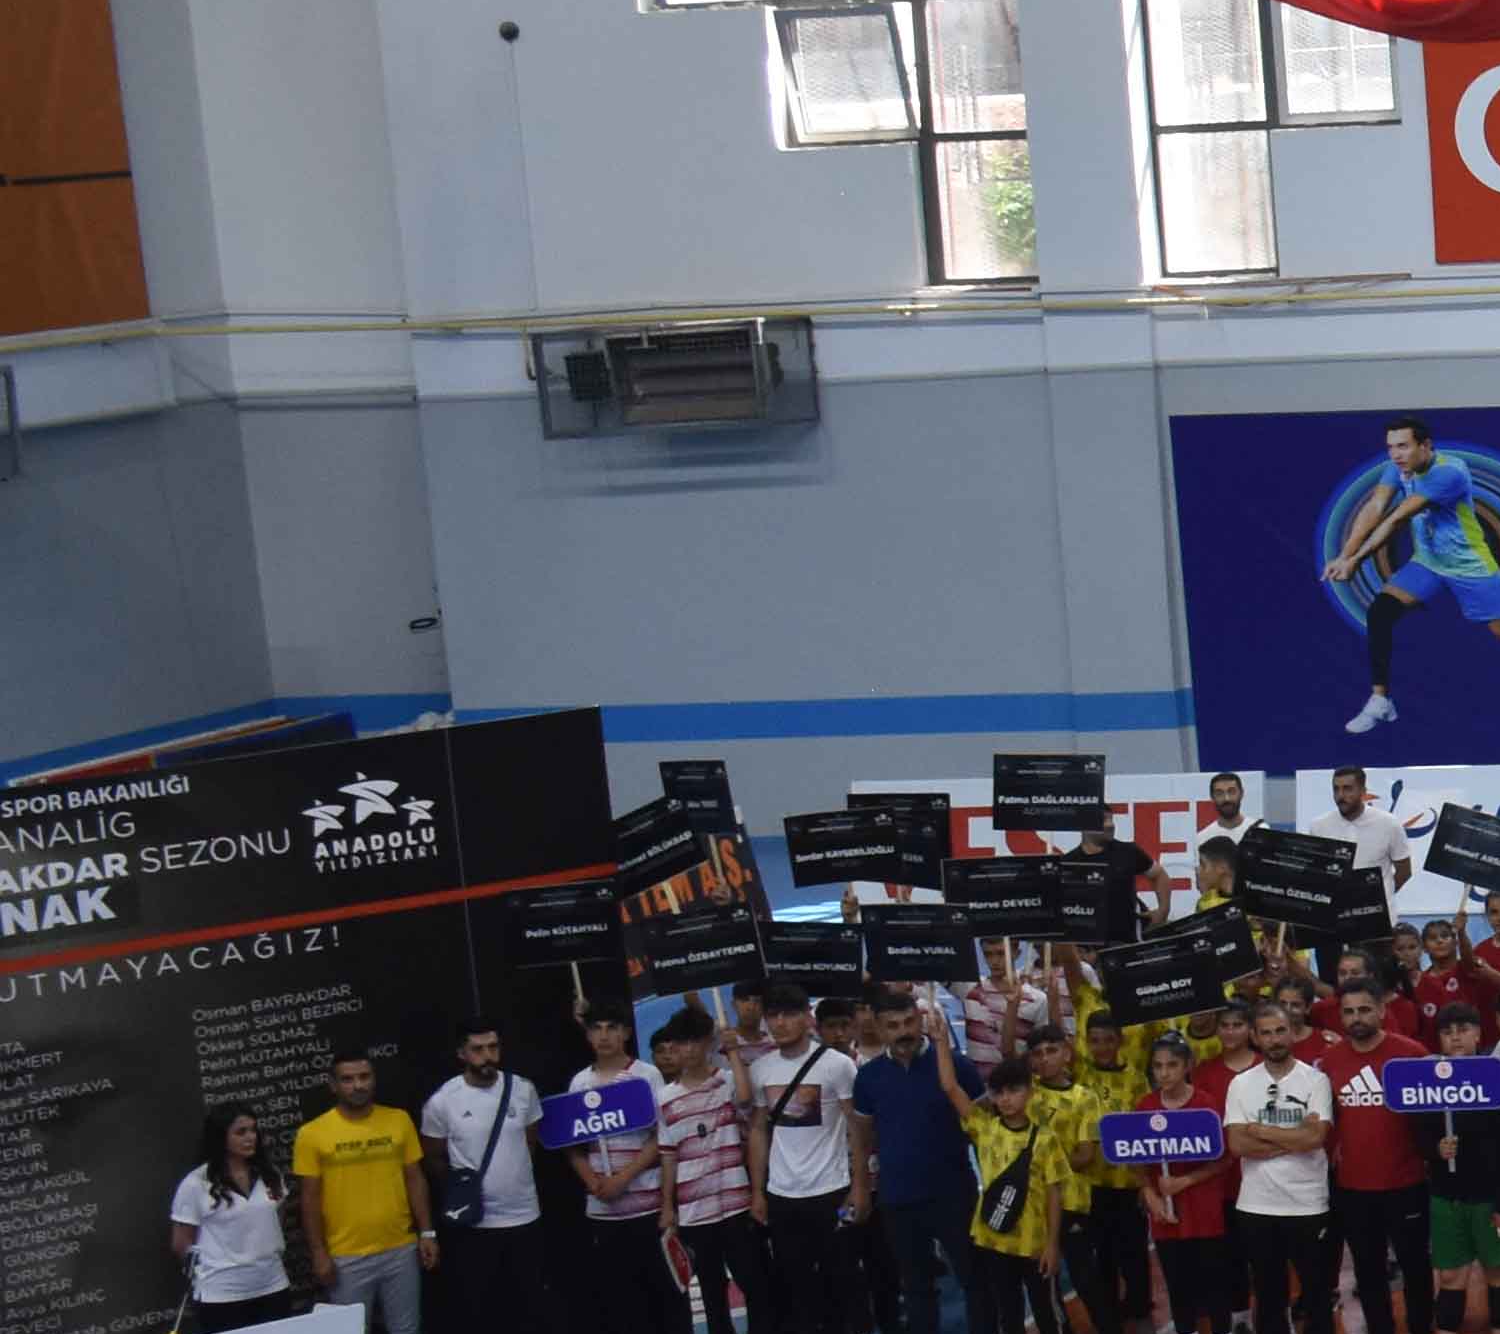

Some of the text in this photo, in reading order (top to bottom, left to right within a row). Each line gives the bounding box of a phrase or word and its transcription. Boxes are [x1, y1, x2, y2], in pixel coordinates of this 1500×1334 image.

[1, 774, 191, 820] SPOR BAKANLIĞI
[140, 828, 291, 873] SEZONU
[315, 827, 436, 859] ANADOLU
[315, 845, 438, 873] YILDIZLARI
[192, 984, 352, 1022] Osman BAYRAKDAR
[1340, 1090, 1384, 1107] adida
[1402, 1080, 1490, 1105] BİNGÖL
[573, 1109, 626, 1137] AĞRI
[1114, 1135, 1211, 1157] BATMAN
